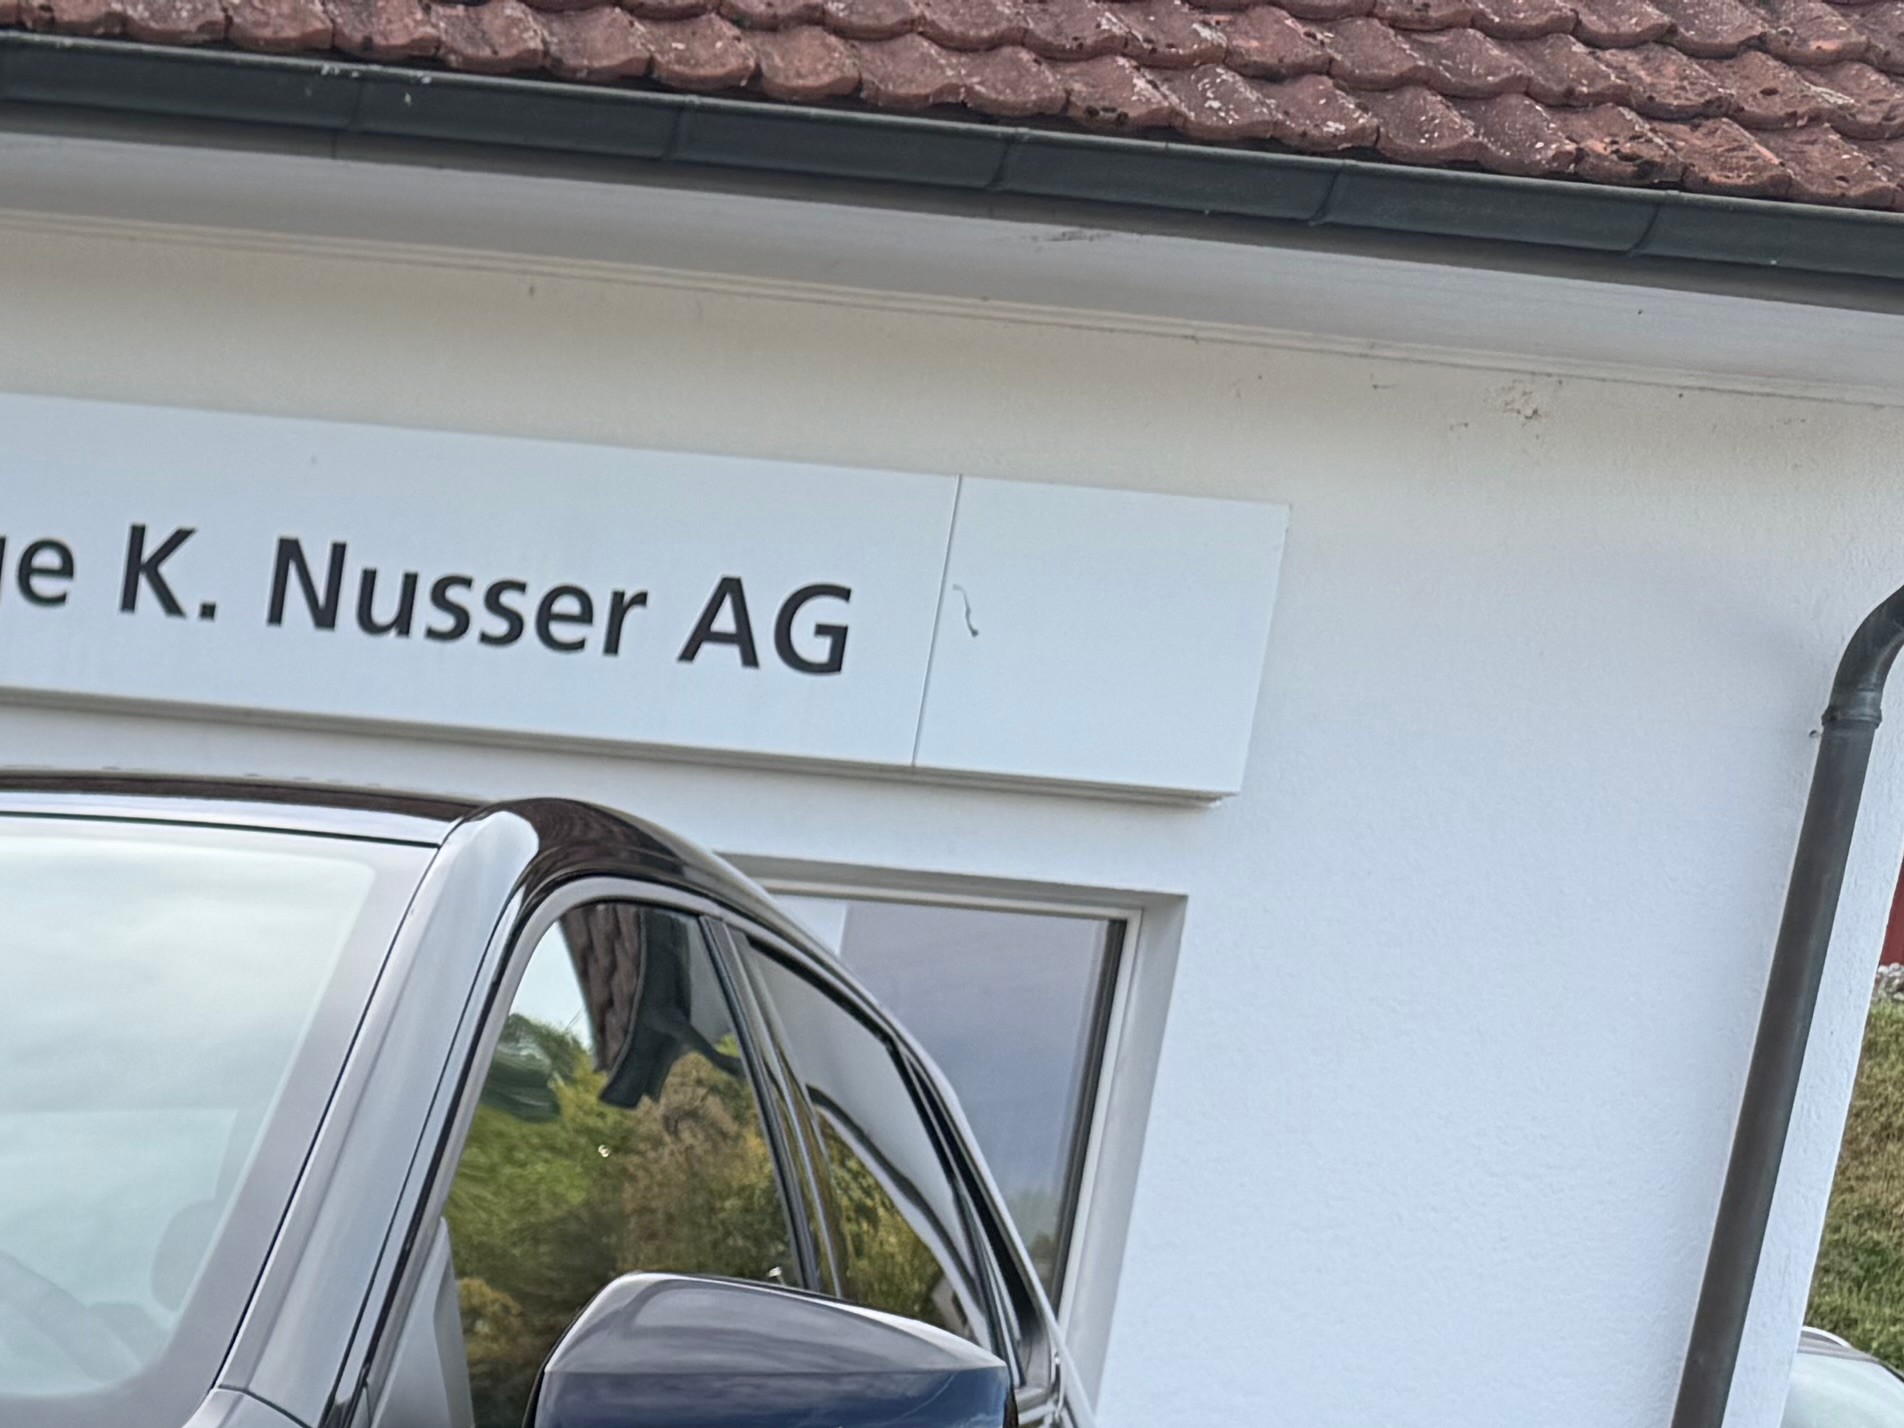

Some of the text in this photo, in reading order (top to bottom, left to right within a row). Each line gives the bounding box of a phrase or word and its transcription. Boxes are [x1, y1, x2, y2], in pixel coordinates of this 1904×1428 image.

[118, 523, 220, 621] K.
[265, 536, 649, 659] Nusser
[676, 575, 855, 677] AG
